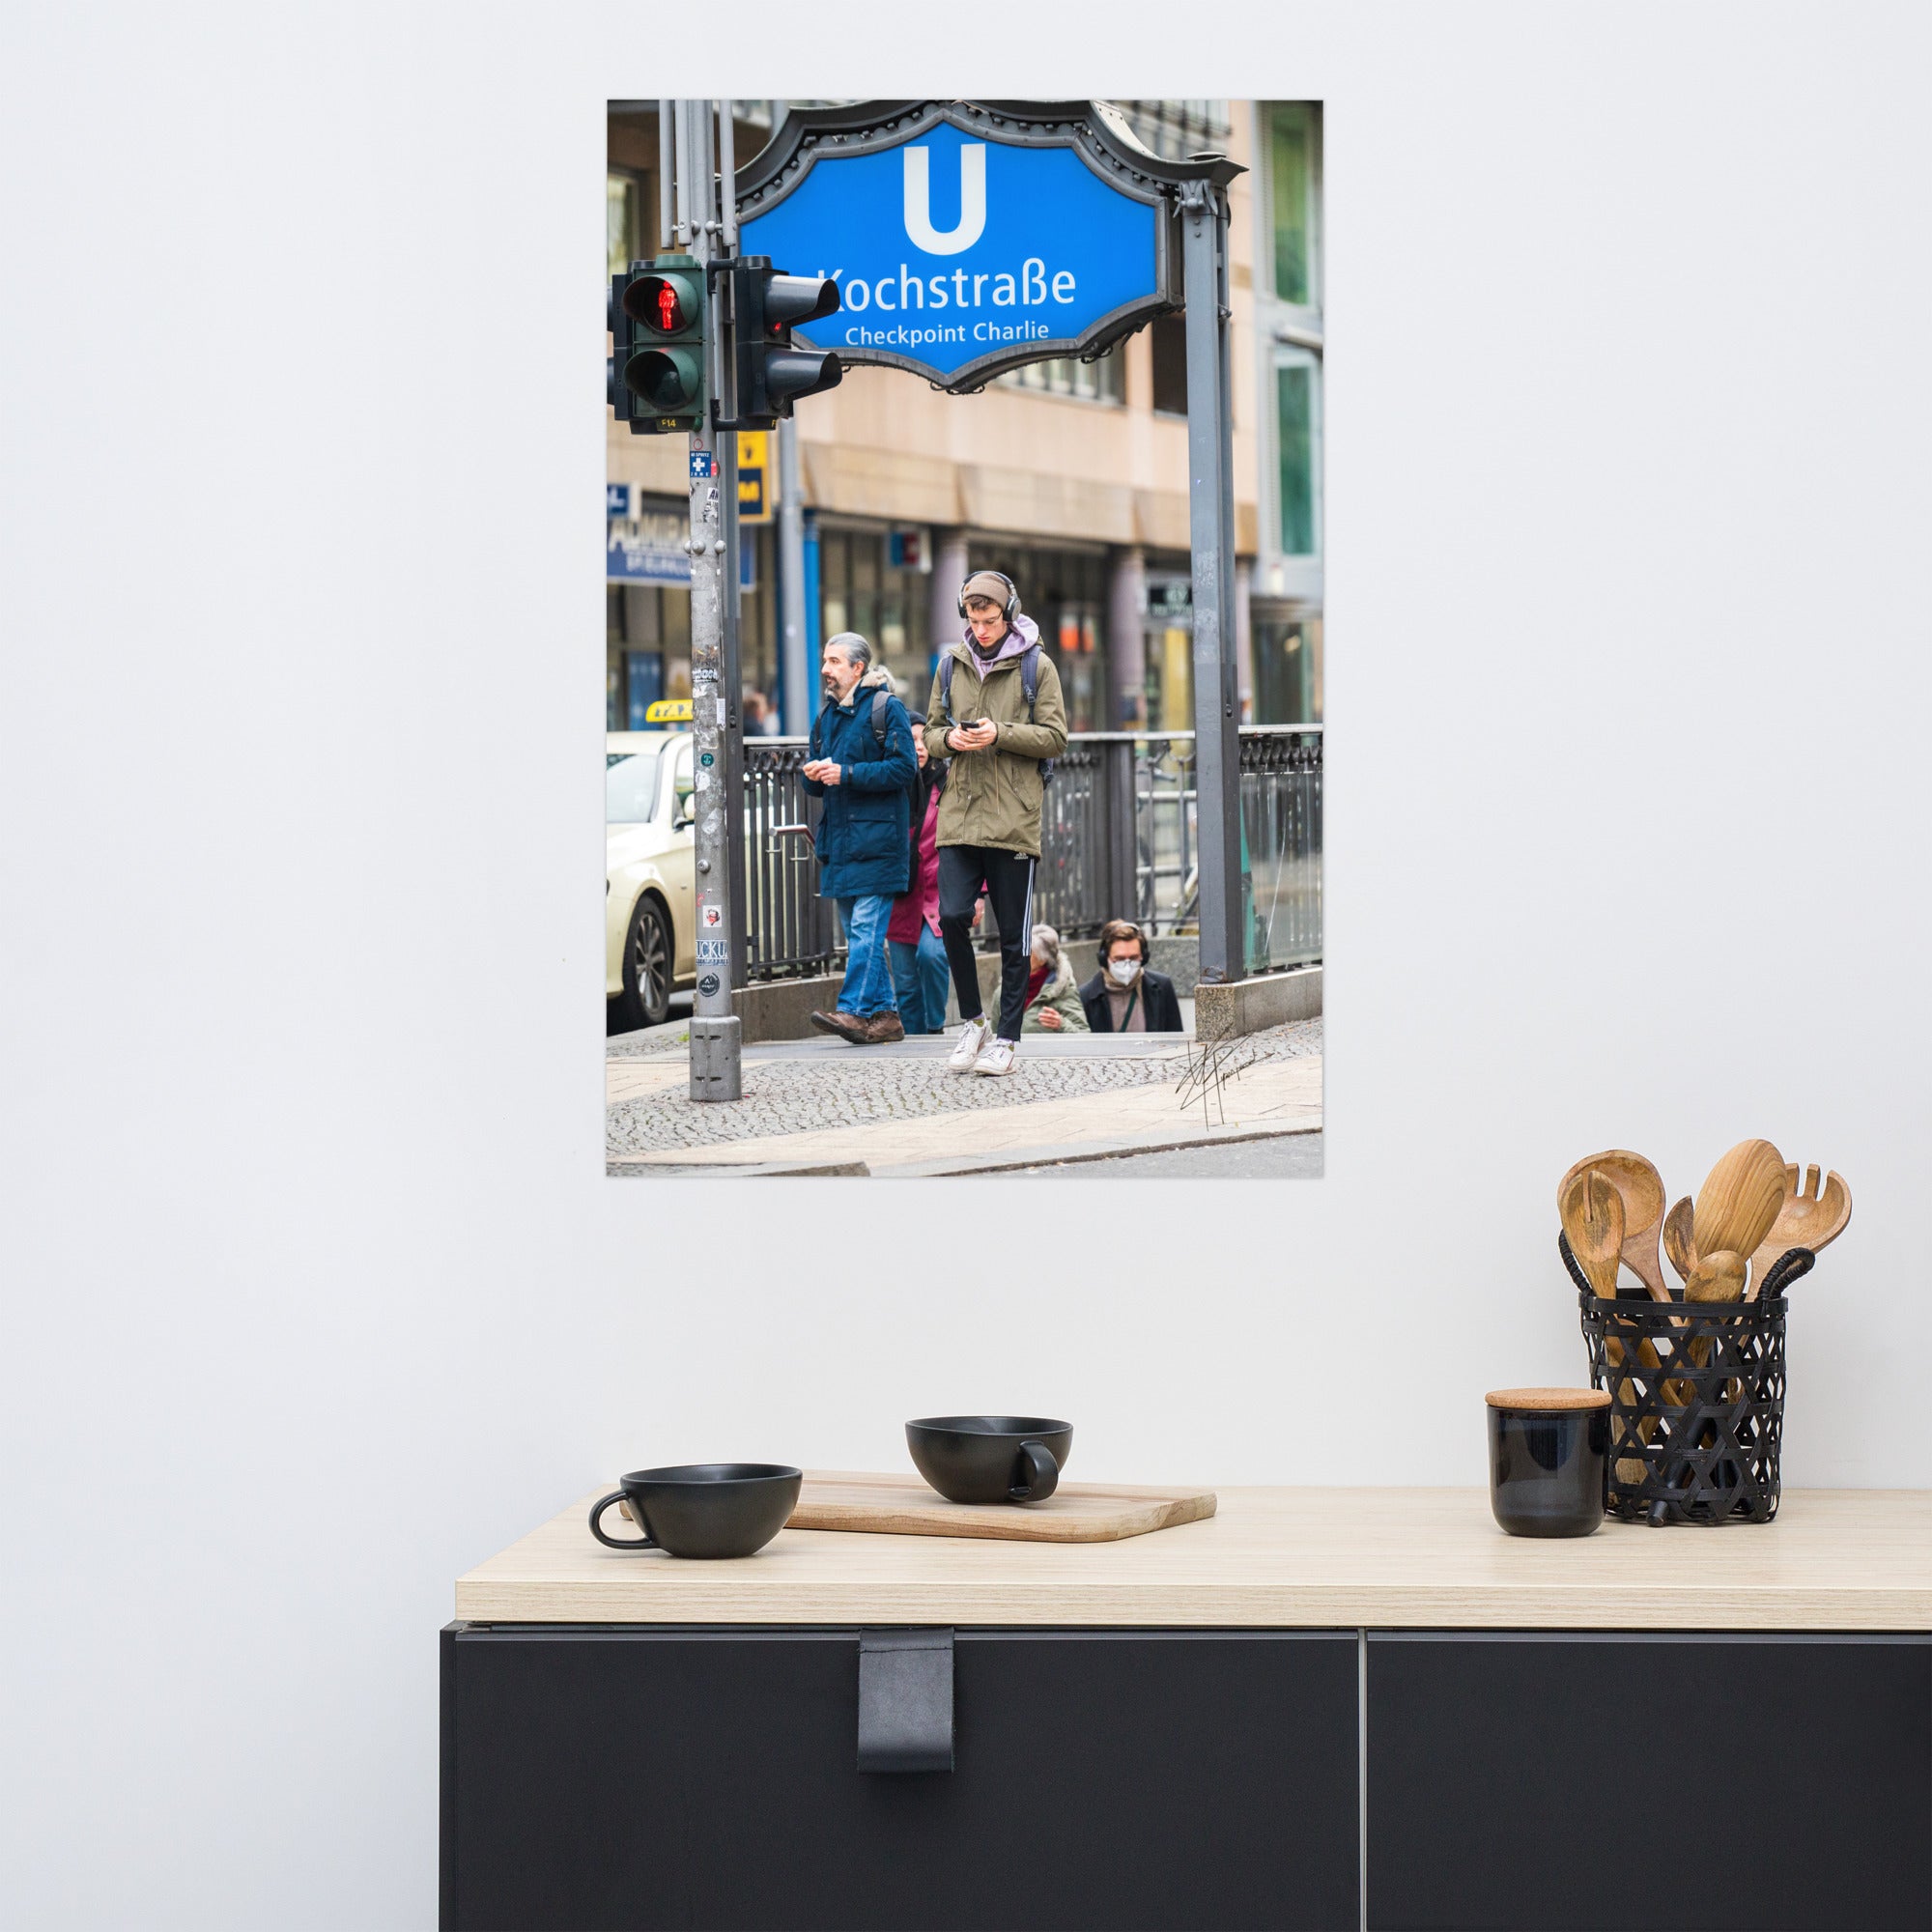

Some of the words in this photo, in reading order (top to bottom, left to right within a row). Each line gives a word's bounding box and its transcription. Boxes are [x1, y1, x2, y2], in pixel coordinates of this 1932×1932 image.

[904, 143, 986, 256] U
[845, 325, 966, 349] Checkpoint
[973, 320, 1049, 341] Charlie
